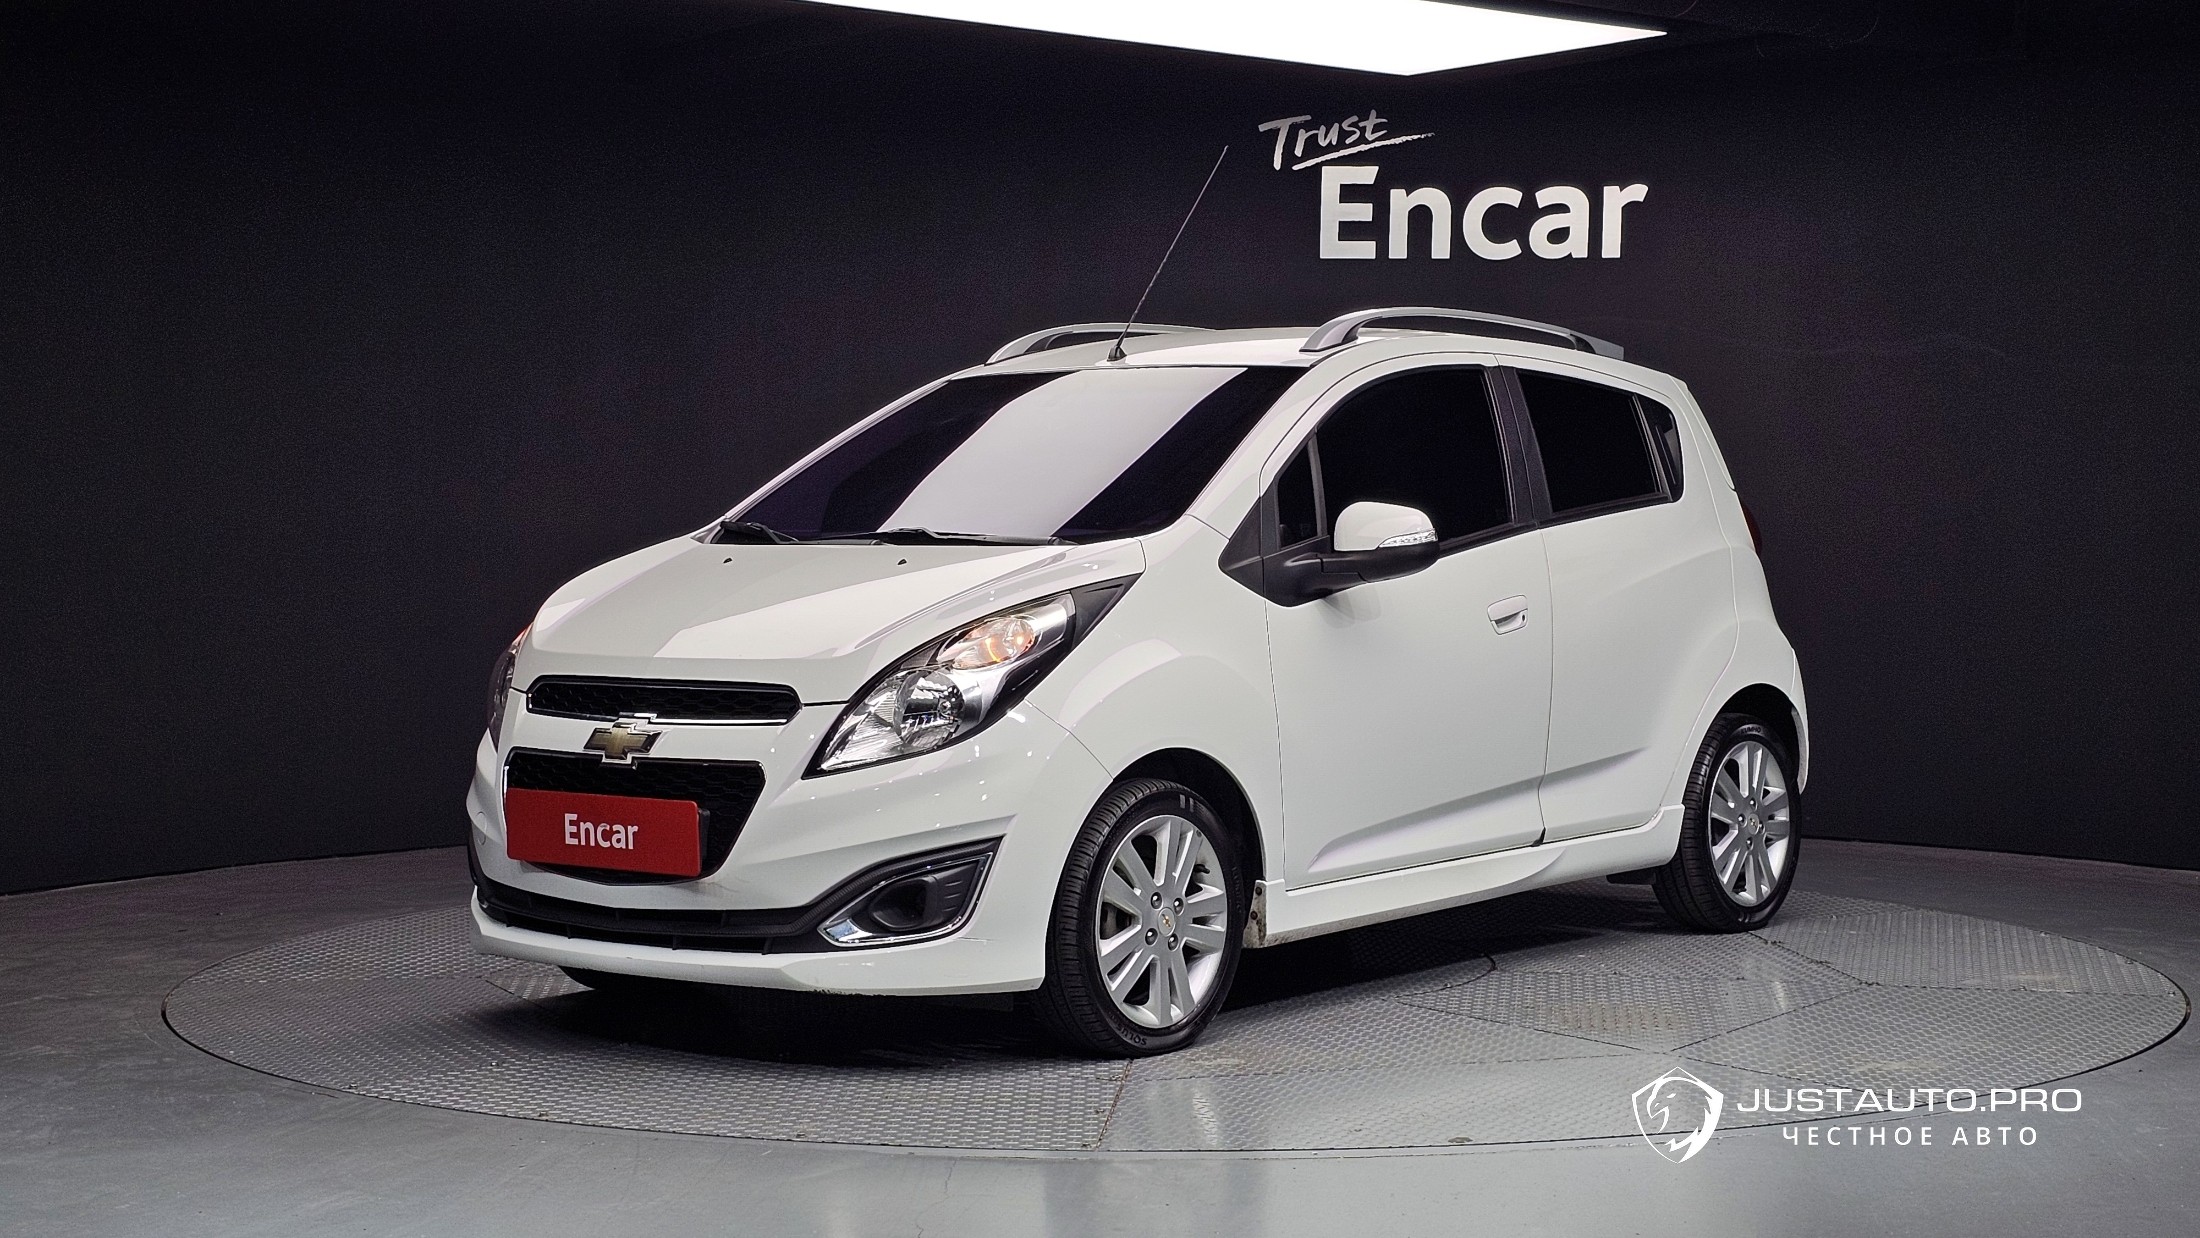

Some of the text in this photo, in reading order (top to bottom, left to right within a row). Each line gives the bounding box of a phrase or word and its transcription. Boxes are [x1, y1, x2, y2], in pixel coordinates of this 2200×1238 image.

[1258, 109, 1388, 171] Trust
[1319, 165, 1649, 260] Encar
[564, 813, 639, 850] Encar
